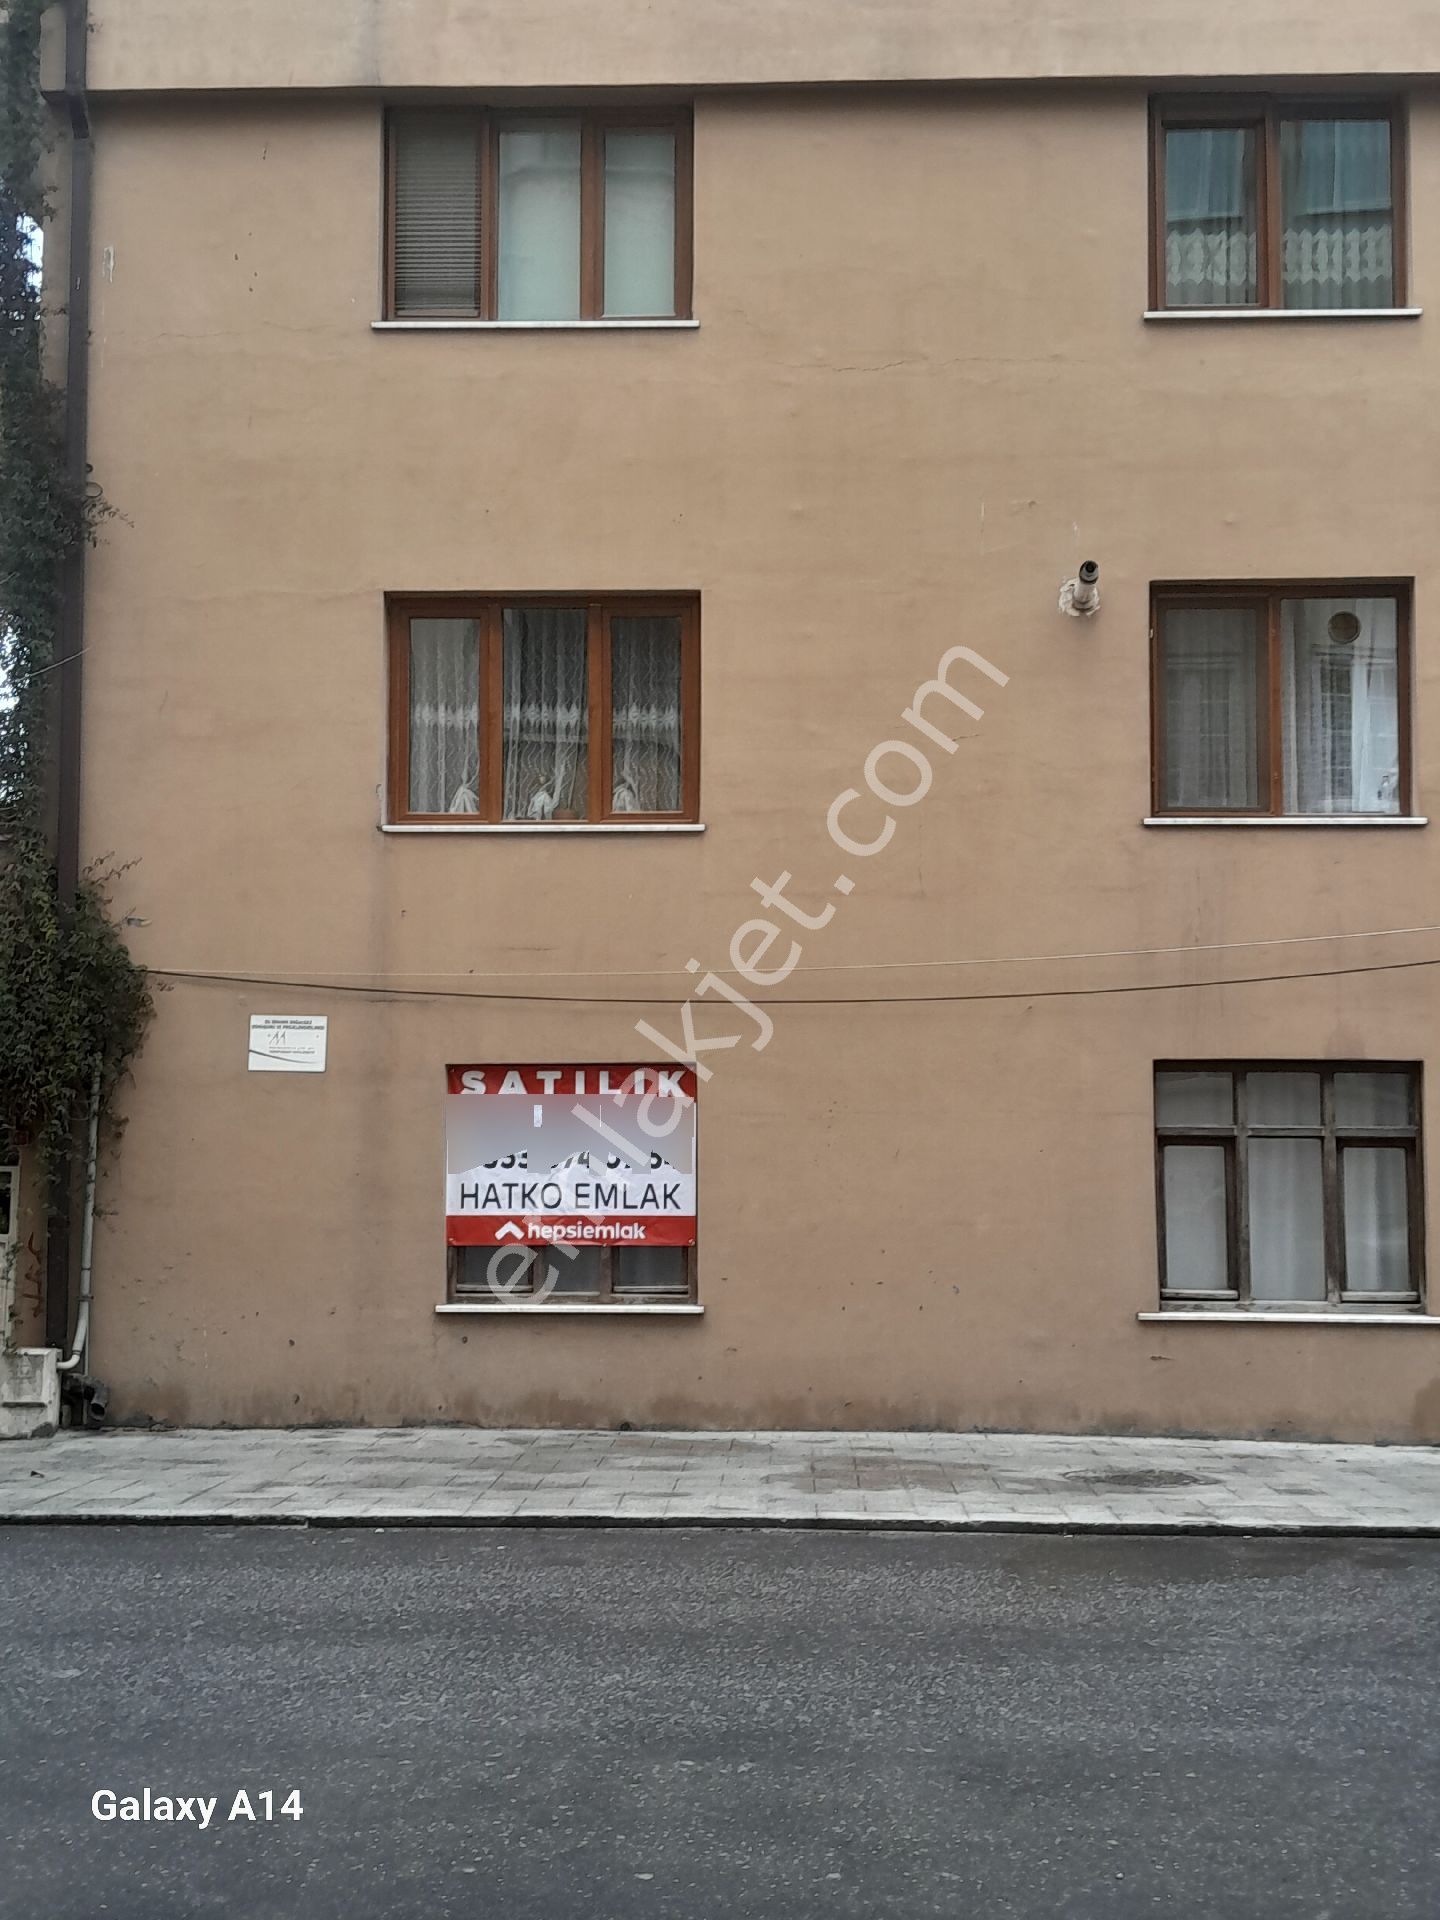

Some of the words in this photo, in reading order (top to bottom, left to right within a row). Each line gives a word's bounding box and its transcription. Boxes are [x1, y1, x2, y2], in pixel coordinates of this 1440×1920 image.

[460, 1070, 687, 1097] SATILIK
[460, 1182, 562, 1210] HATKO
[575, 1182, 682, 1210] EMLAK
[527, 1221, 647, 1241] hepsiemlak
